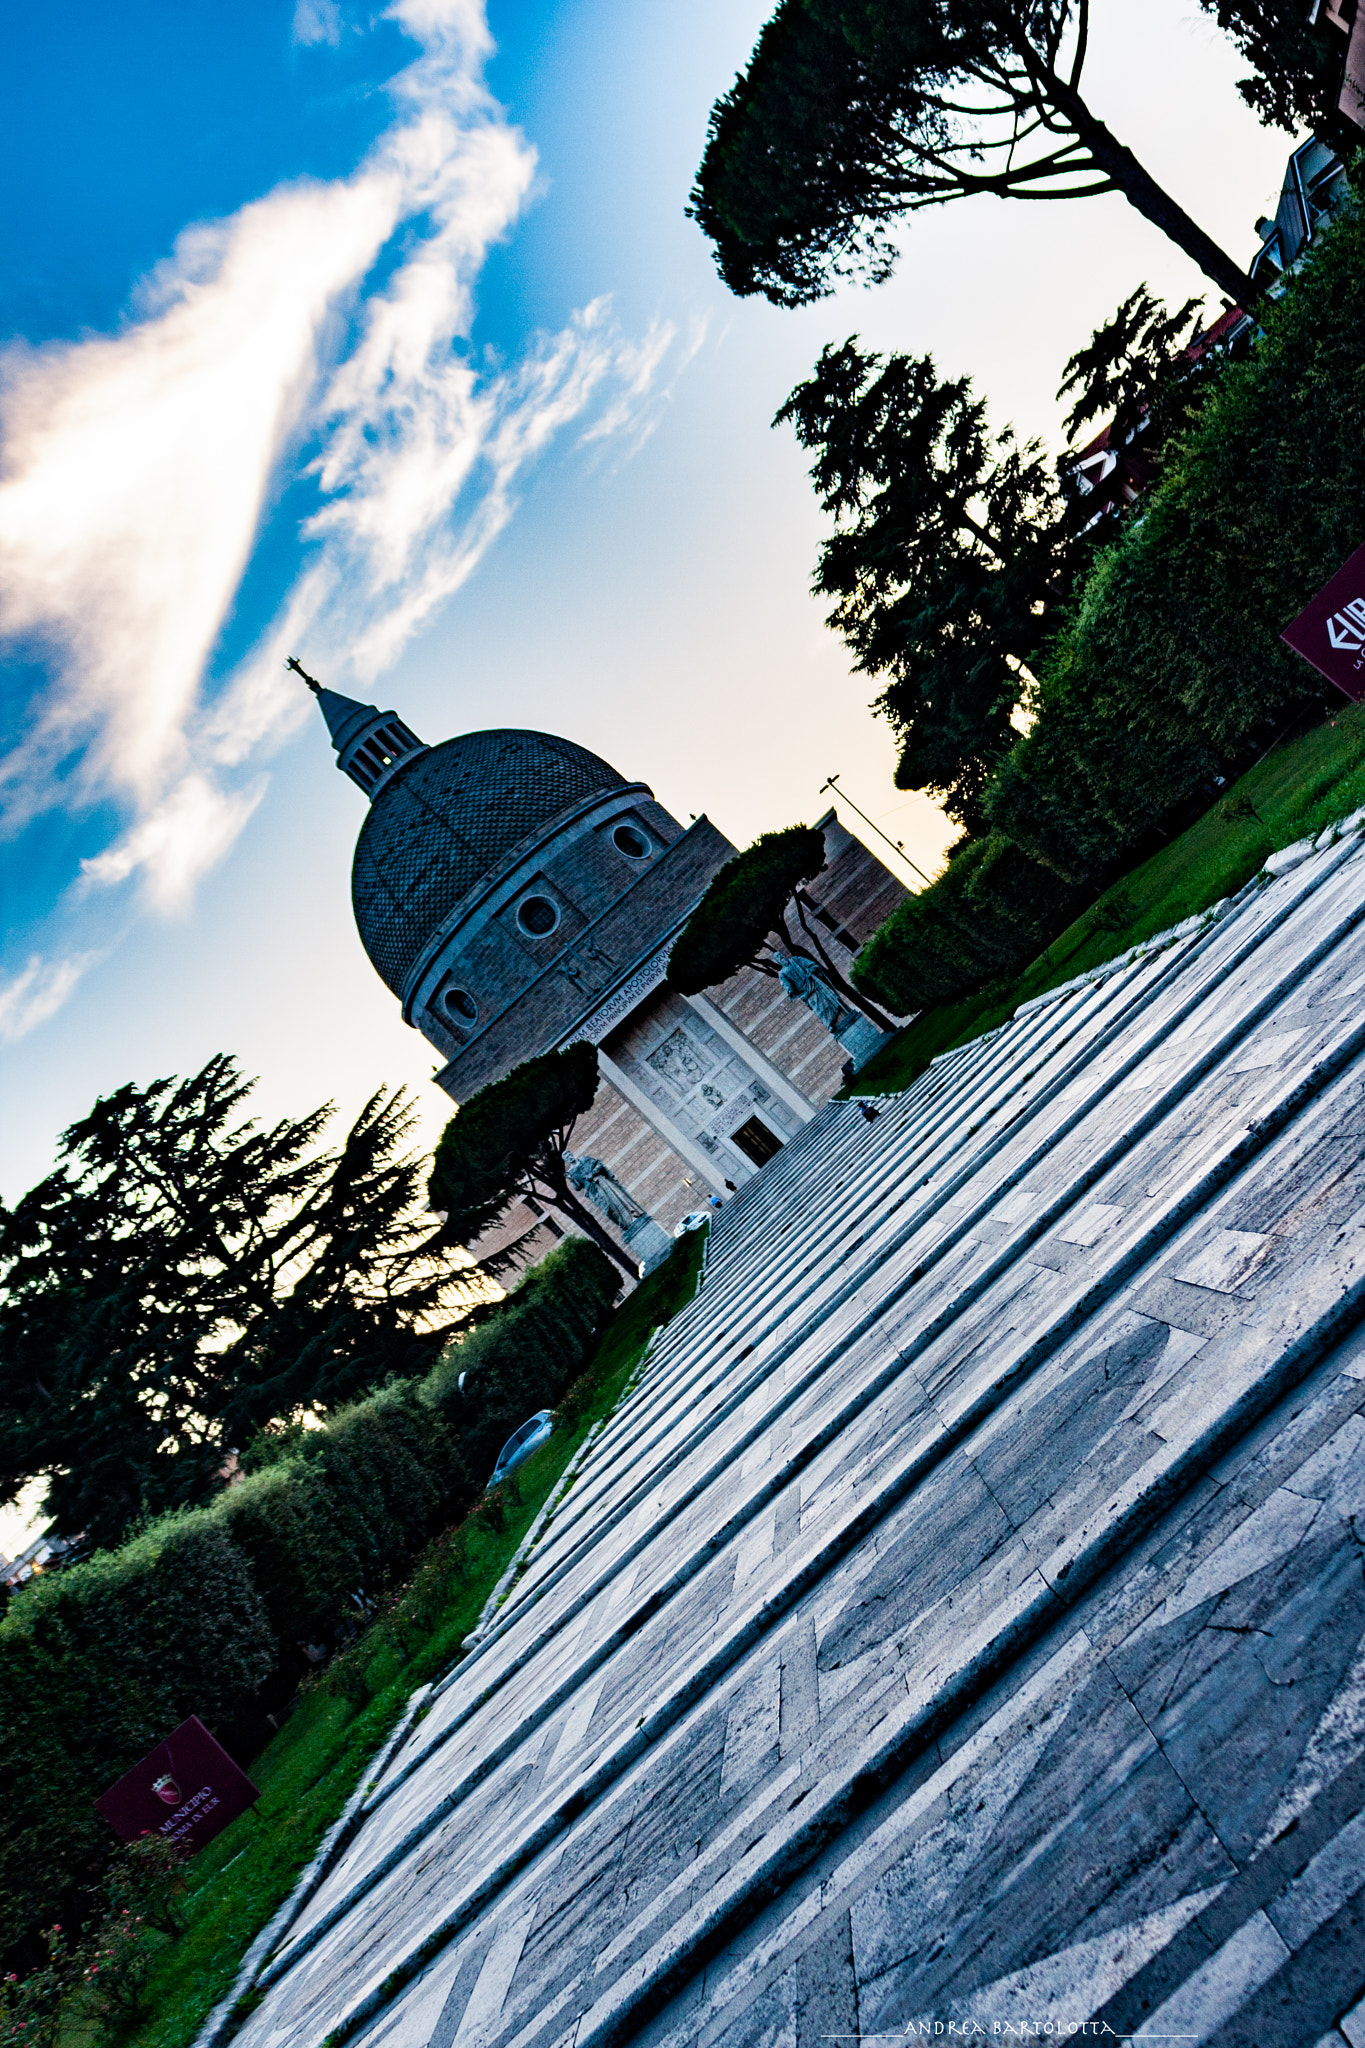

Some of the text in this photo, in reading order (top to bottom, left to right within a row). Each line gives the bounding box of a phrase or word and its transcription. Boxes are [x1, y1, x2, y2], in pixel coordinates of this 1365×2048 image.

[586, 994, 624, 1031] BEATORVM
[623, 946, 671, 996] APOSTOLORVM
[607, 994, 637, 1023] PRINCIPVM
[159, 1786, 212, 1835] MUNICIPIO
[201, 1797, 220, 1814] EUR
